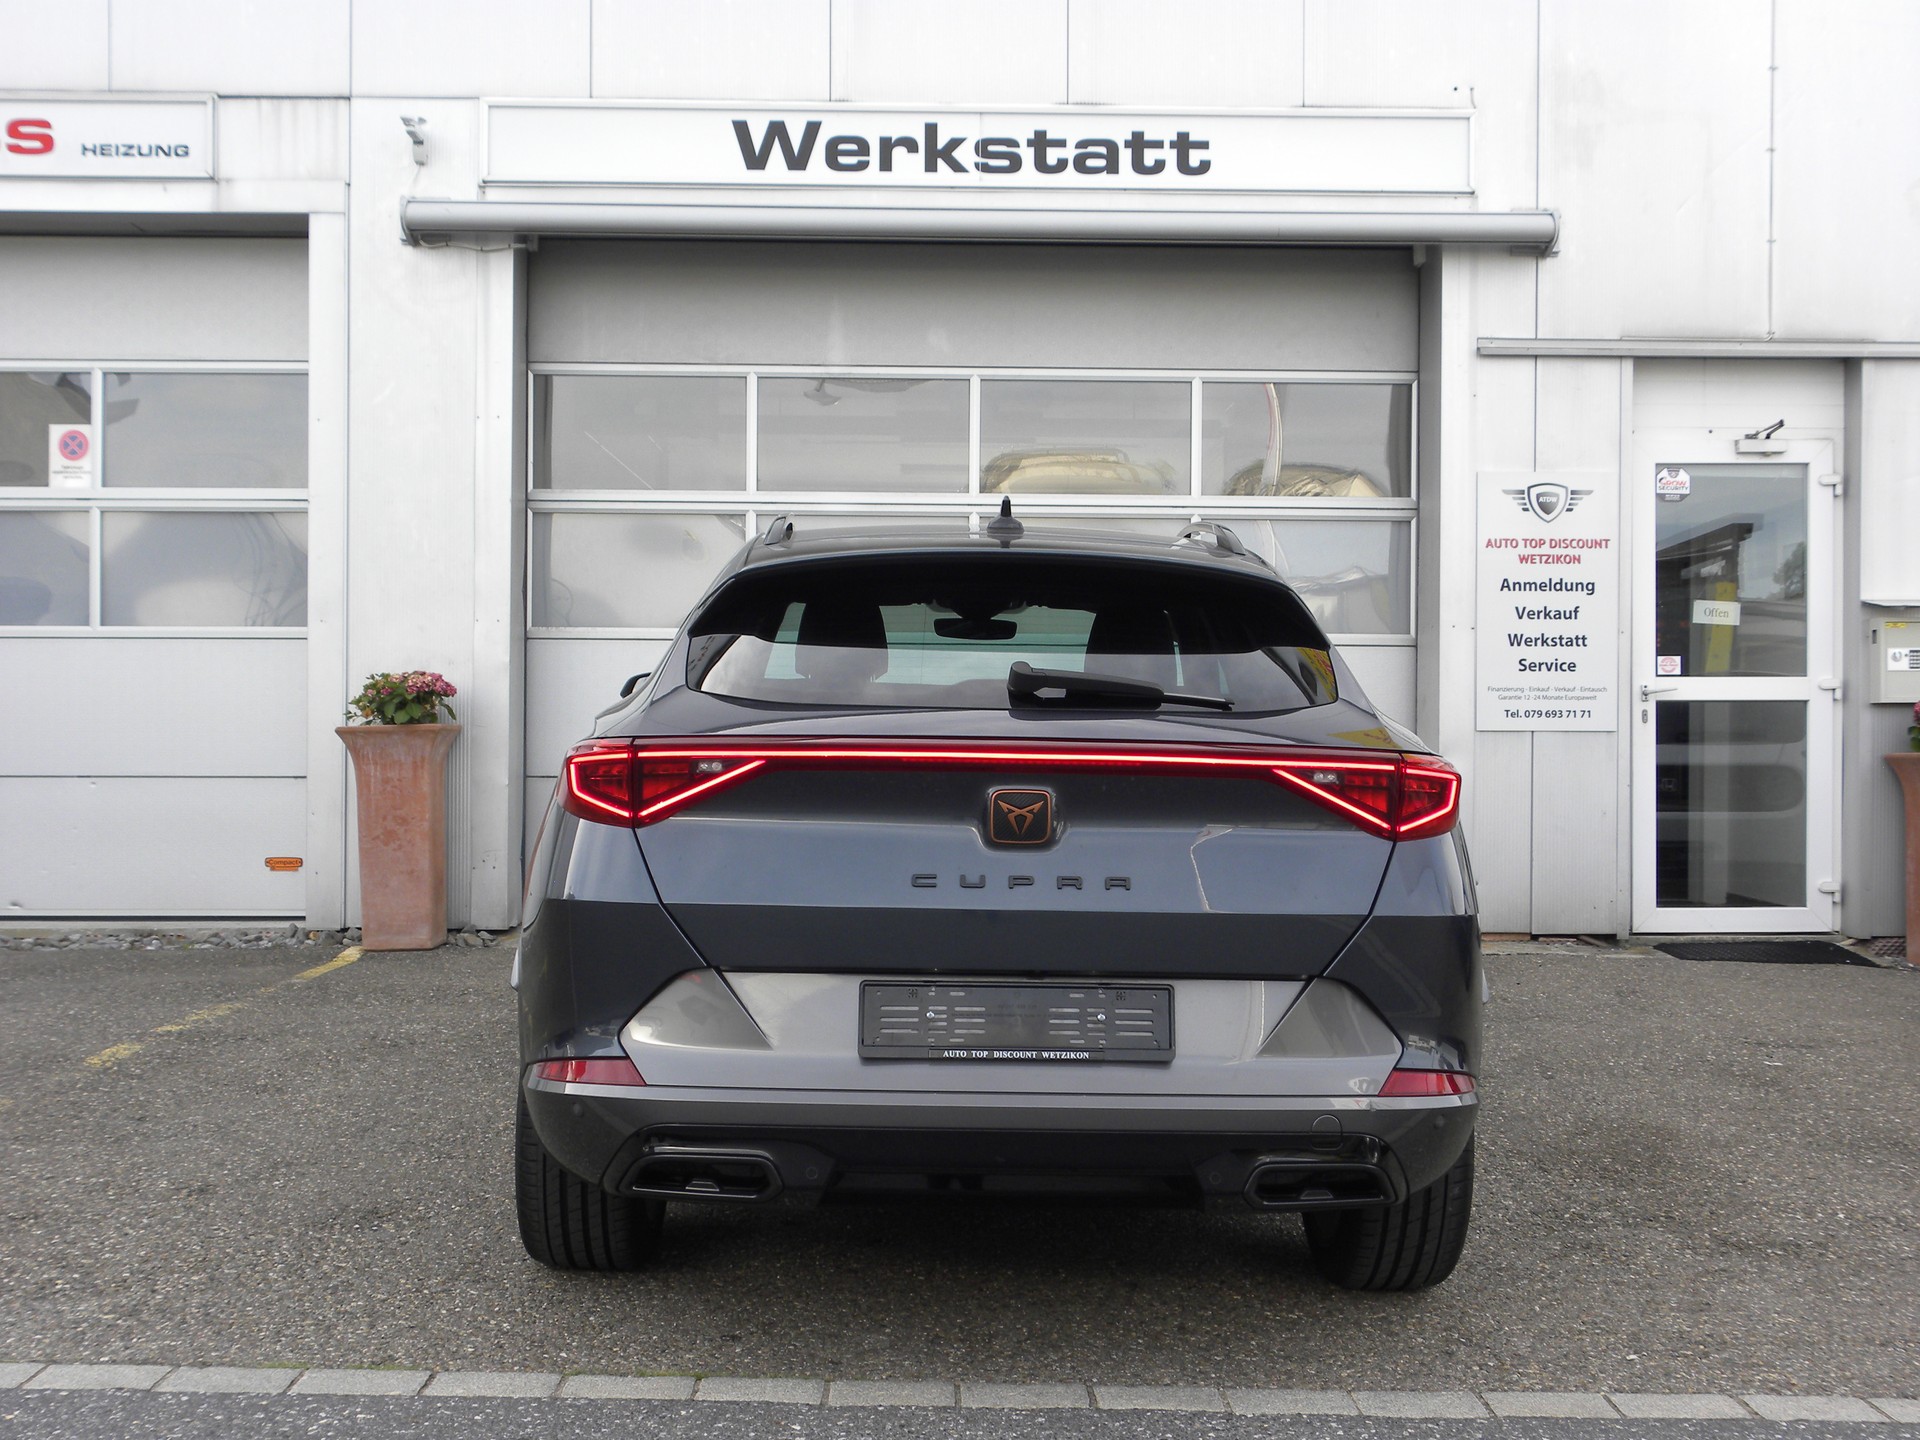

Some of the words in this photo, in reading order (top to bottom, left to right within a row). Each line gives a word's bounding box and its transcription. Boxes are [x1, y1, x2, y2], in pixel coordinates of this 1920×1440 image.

[80, 143, 190, 158] HEIZUNG
[731, 119, 1212, 176] Werkstatt
[1485, 538, 1519, 549] AUTO
[1522, 538, 1546, 549] TOP
[1549, 538, 1611, 549] DISCOUNT
[1518, 554, 1581, 565] WETZIKON
[1500, 578, 1596, 595] Anmeldung
[1515, 606, 1580, 620] Verkauf
[1703, 606, 1729, 619] Offen
[1507, 633, 1588, 647] Werkstatt
[1518, 658, 1577, 672] Service
[1565, 694, 1597, 702] Europaweit
[1504, 709, 1522, 718] Tel.
[1524, 709, 1543, 718] 079
[1544, 709, 1563, 718] 693
[1566, 709, 1577, 718] 71
[1580, 709, 1592, 718] 71
[911, 873, 1131, 891] CUPRA
[943, 1050, 967, 1058] AUTO
[971, 1050, 989, 1058] TOP
[993, 1051, 1037, 1059] DISCOUNT
[1041, 1051, 1089, 1059] WETZIKON
